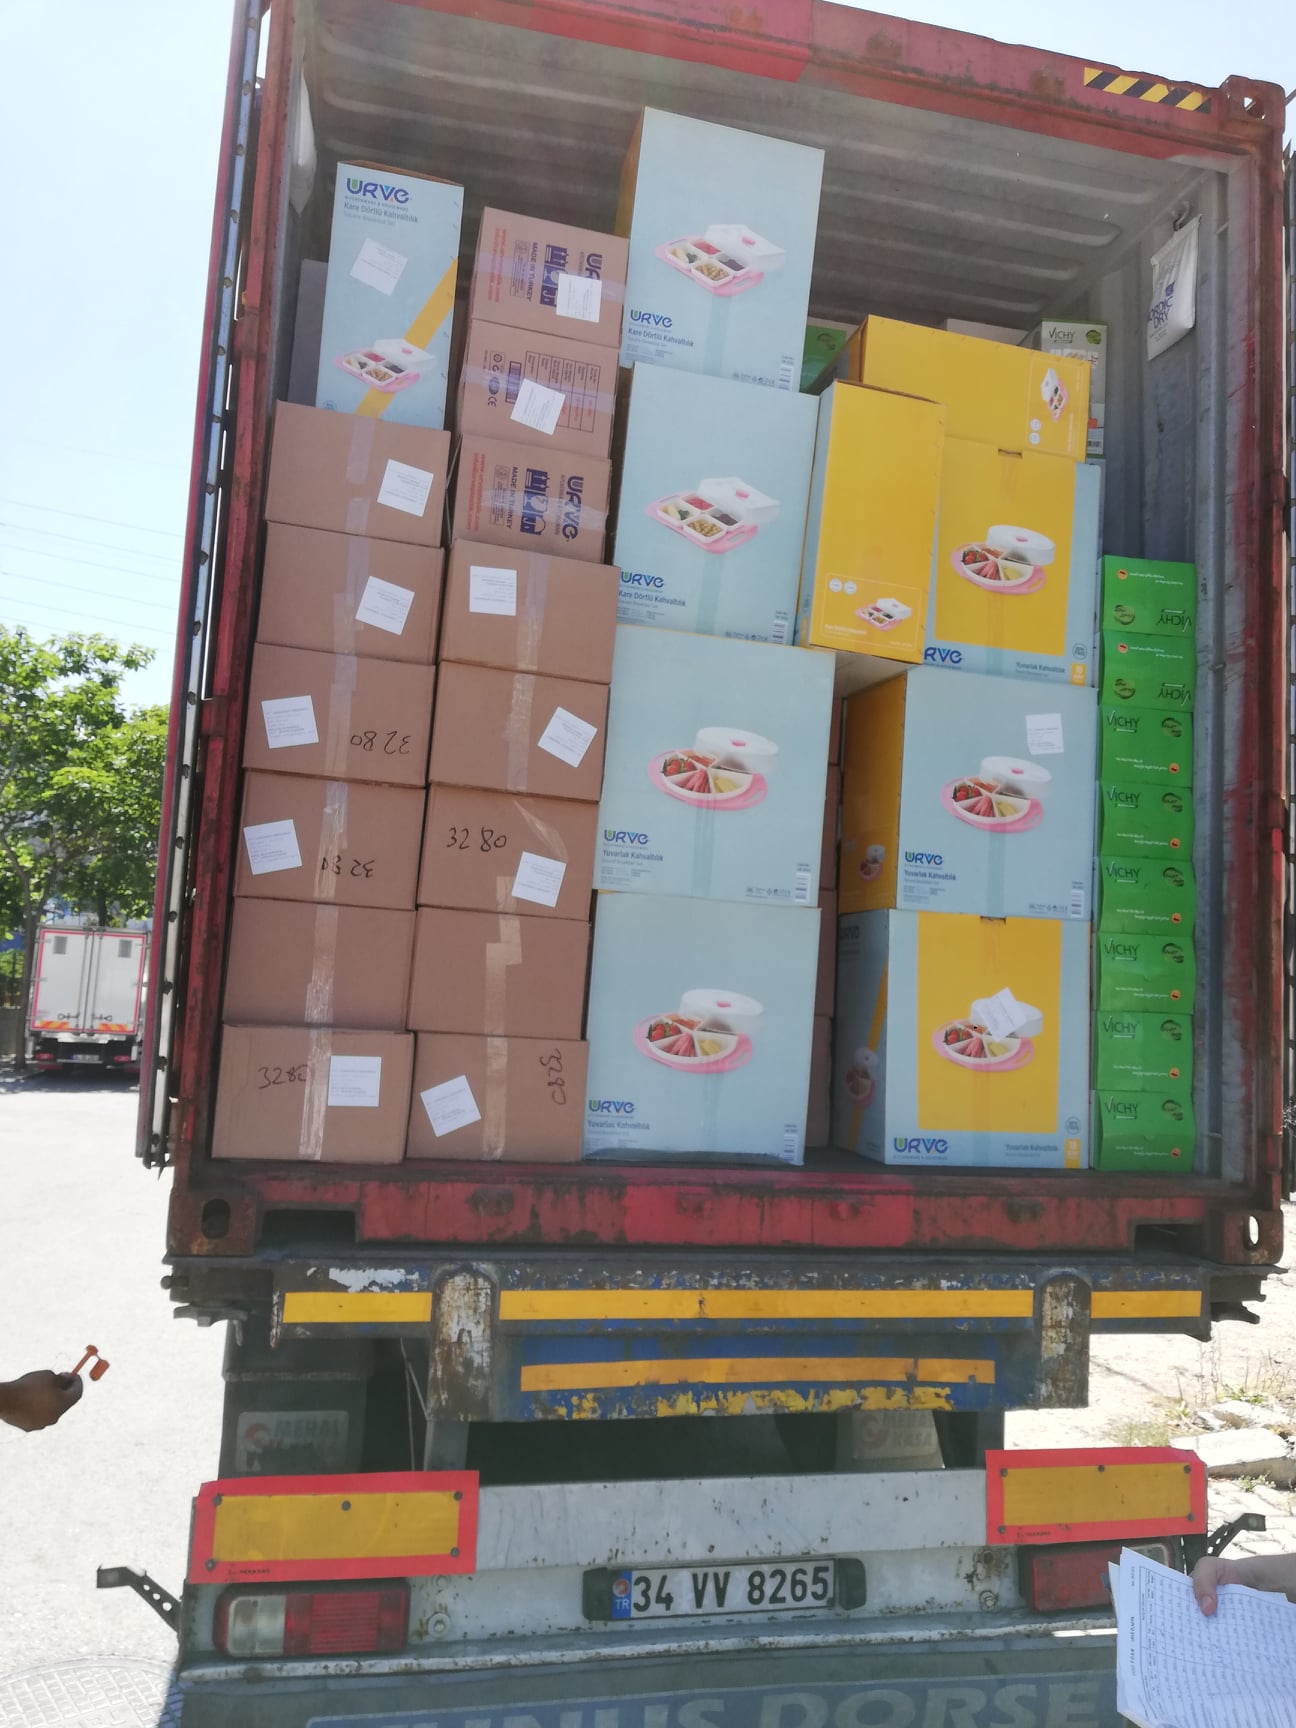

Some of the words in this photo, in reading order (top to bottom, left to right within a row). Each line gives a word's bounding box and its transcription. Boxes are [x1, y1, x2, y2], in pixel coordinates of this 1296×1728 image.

[344, 202, 359, 212] Kare
[1153, 308, 1170, 329] DRY
[510, 466, 519, 488] MADE
[1106, 710, 1140, 728] VICHY
[1107, 785, 1142, 803] VICHY
[1106, 861, 1142, 879] VICHY
[1105, 938, 1140, 956] VICHY
[1103, 1016, 1138, 1033] VICHY
[1104, 1096, 1139, 1114] VICHY
[632, 1575, 674, 1613] 34
[691, 1571, 731, 1609] VV
[747, 1566, 830, 1606] 8265
[615, 1599, 630, 1611] TR
